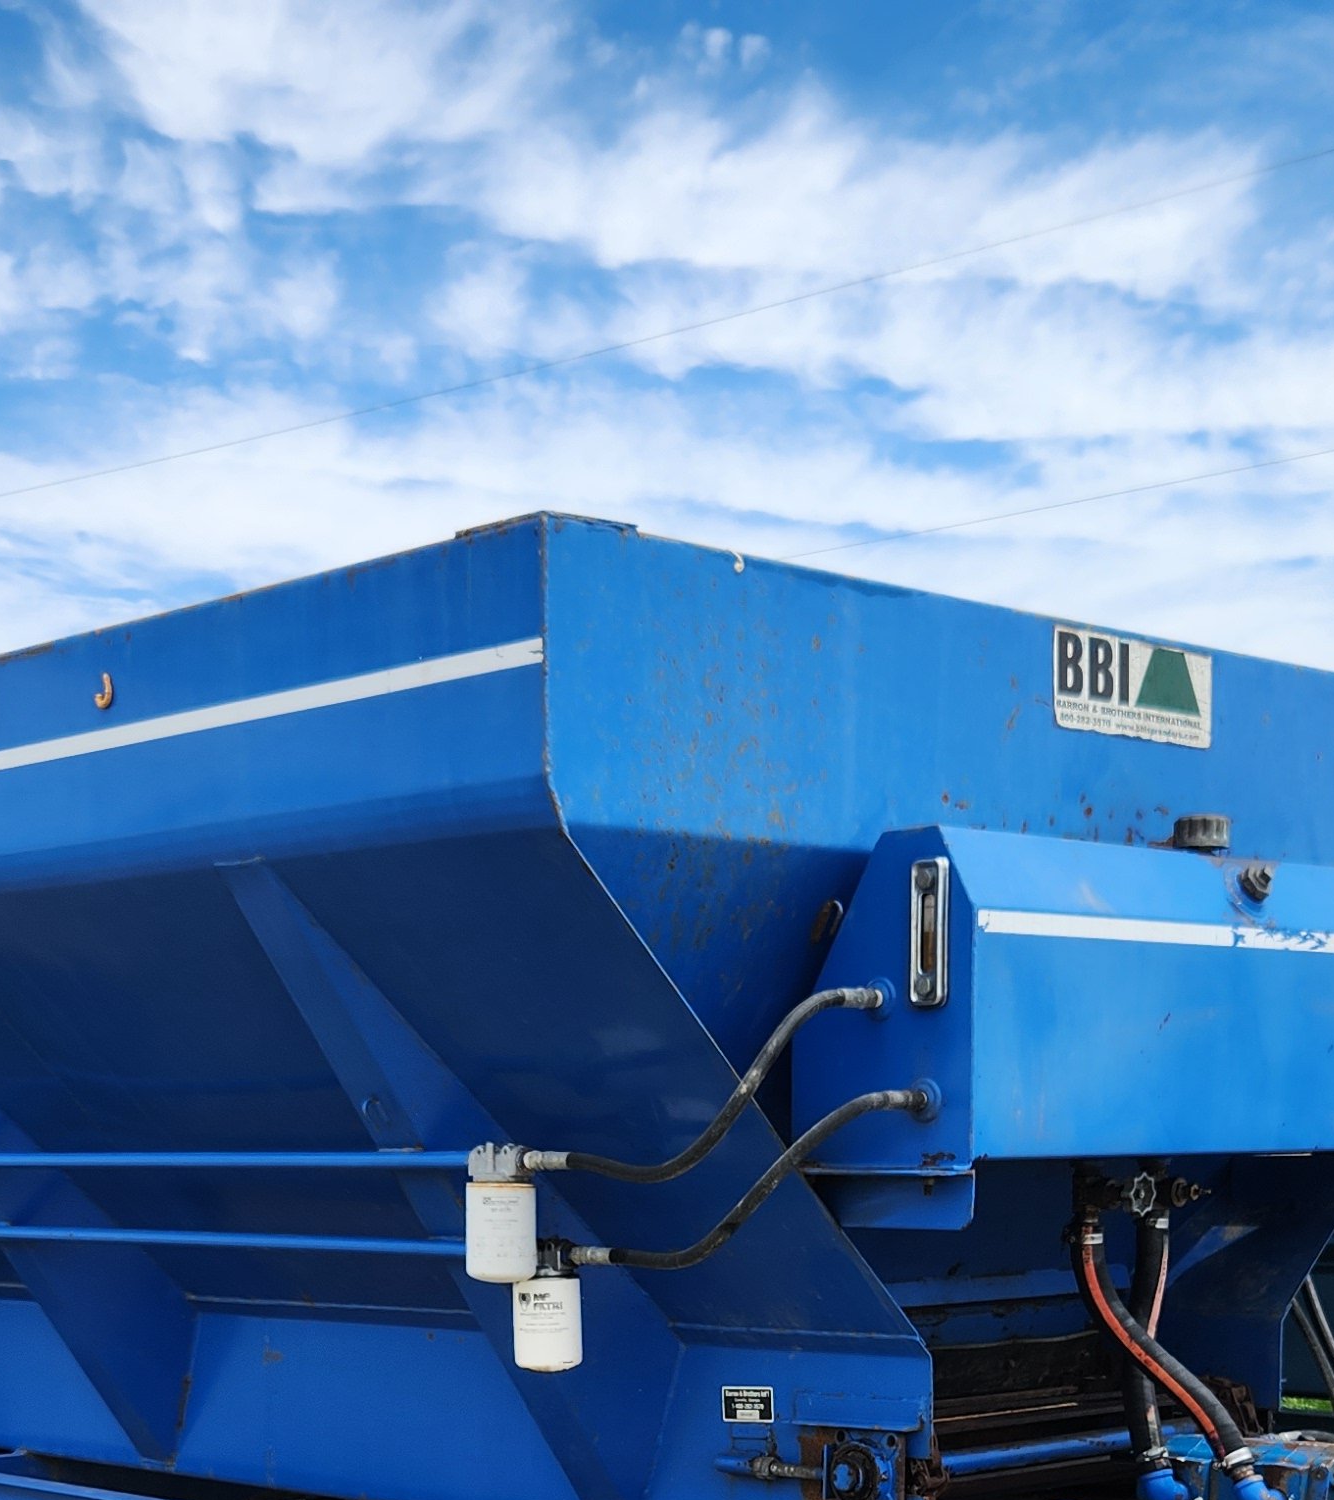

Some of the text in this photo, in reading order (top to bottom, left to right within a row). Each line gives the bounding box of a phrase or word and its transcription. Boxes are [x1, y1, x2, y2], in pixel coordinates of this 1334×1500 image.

[1057, 631, 1130, 706] BBI
[1056, 699, 1089, 712] BARRON
[1100, 707, 1142, 720] BROTHERS
[1143, 712, 1202, 730] INTERNATIONAL
